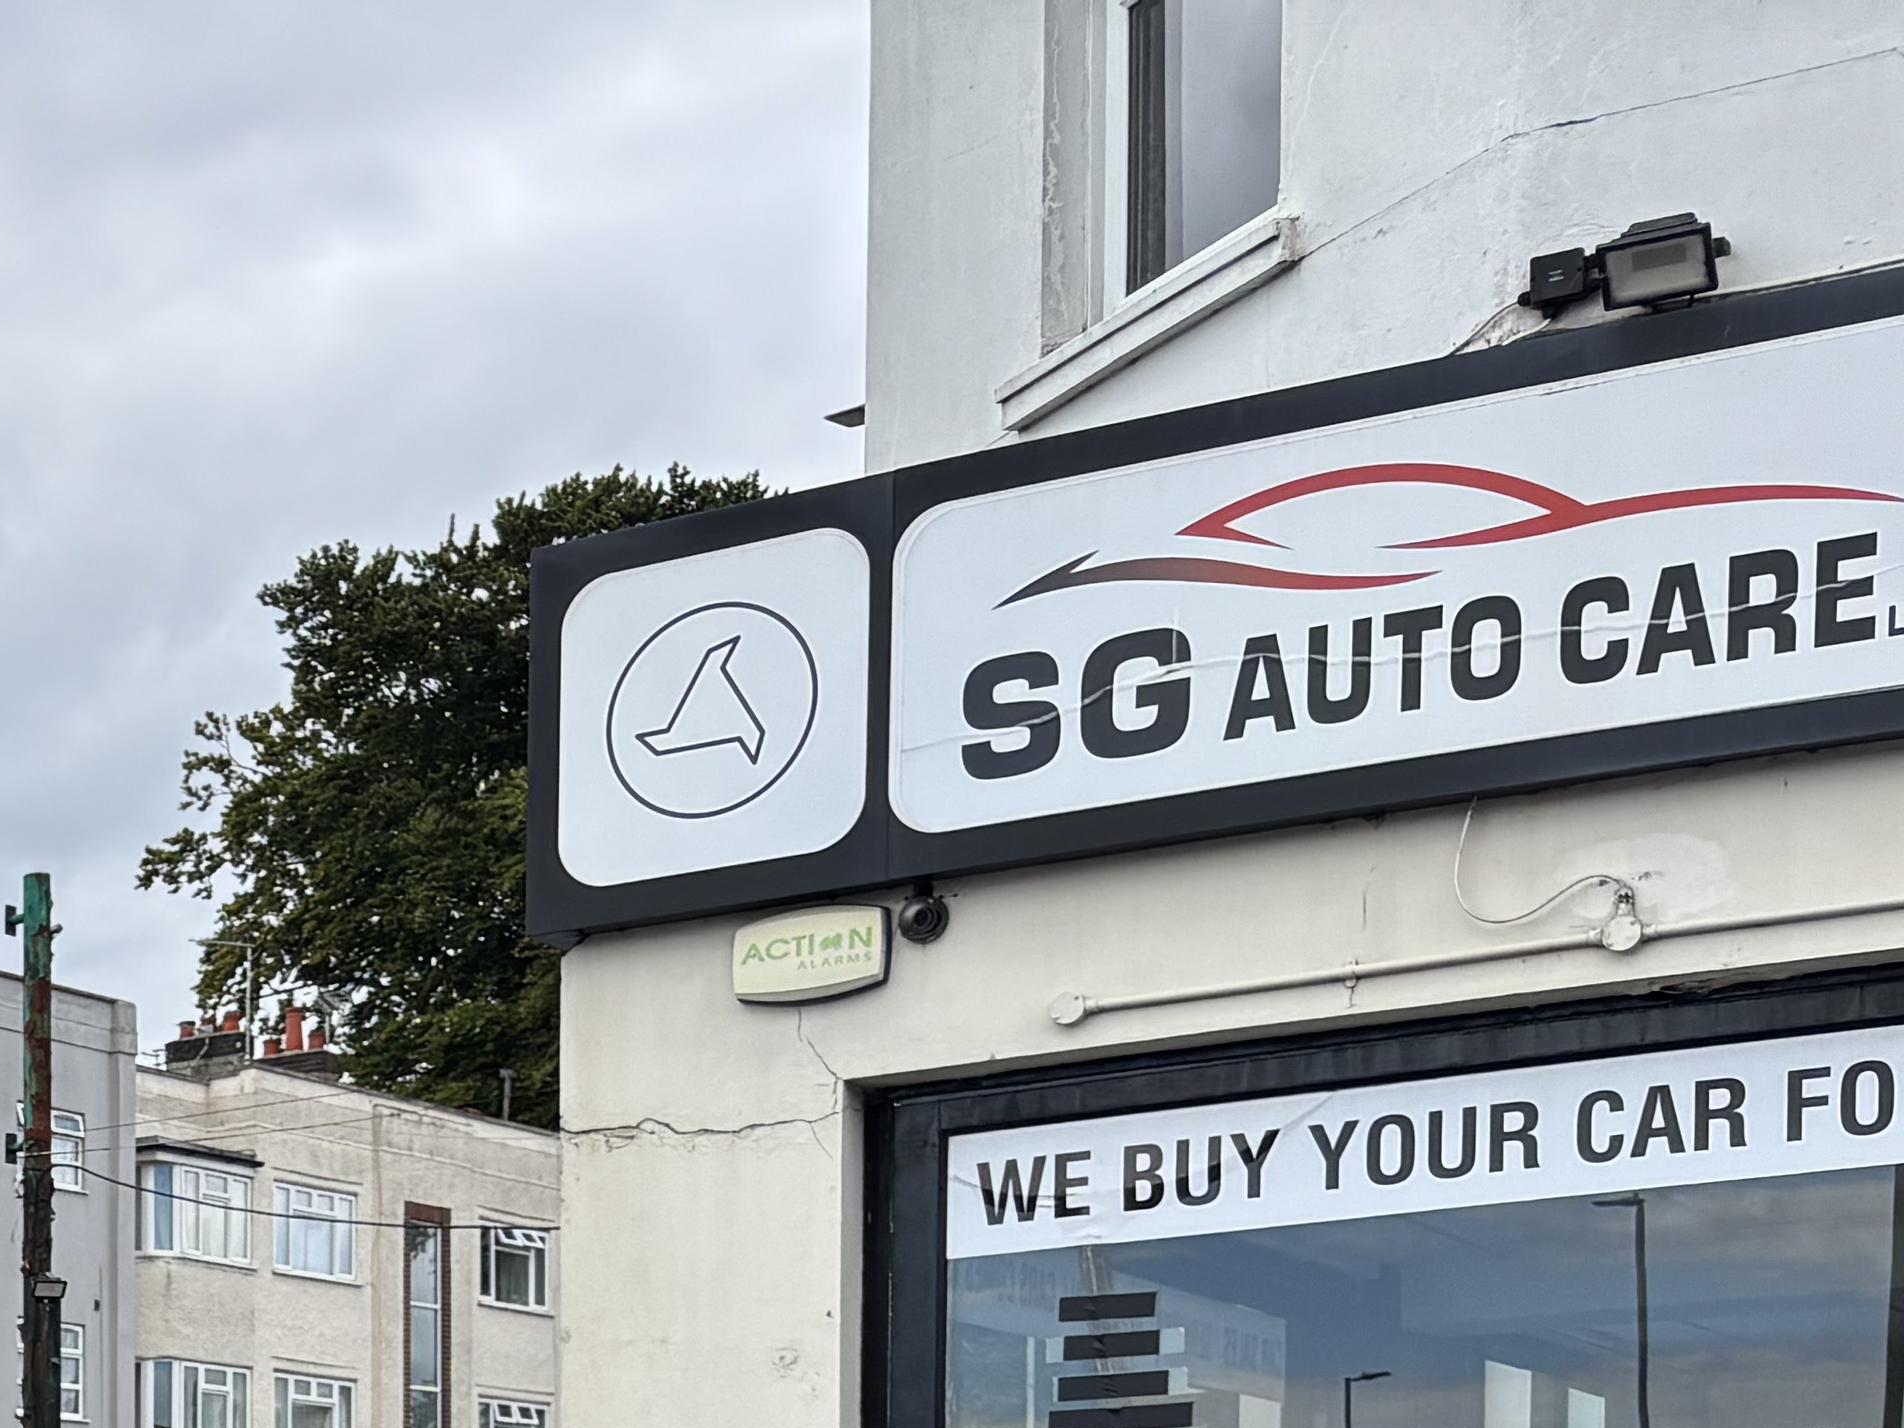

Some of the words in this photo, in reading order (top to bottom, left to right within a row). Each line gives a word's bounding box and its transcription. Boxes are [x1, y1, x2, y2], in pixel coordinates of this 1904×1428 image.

[960, 626, 1193, 780] SG
[1222, 594, 1523, 742] AUTO
[1558, 531, 1879, 685] CARE
[796, 950, 873, 971] ALARMS
[976, 1149, 1093, 1226] WE
[1120, 1128, 1282, 1213] BUY
[1307, 1099, 1541, 1192] YOUR
[1575, 1075, 1748, 1165] CAR
[1786, 1060, 1895, 1142] FO
